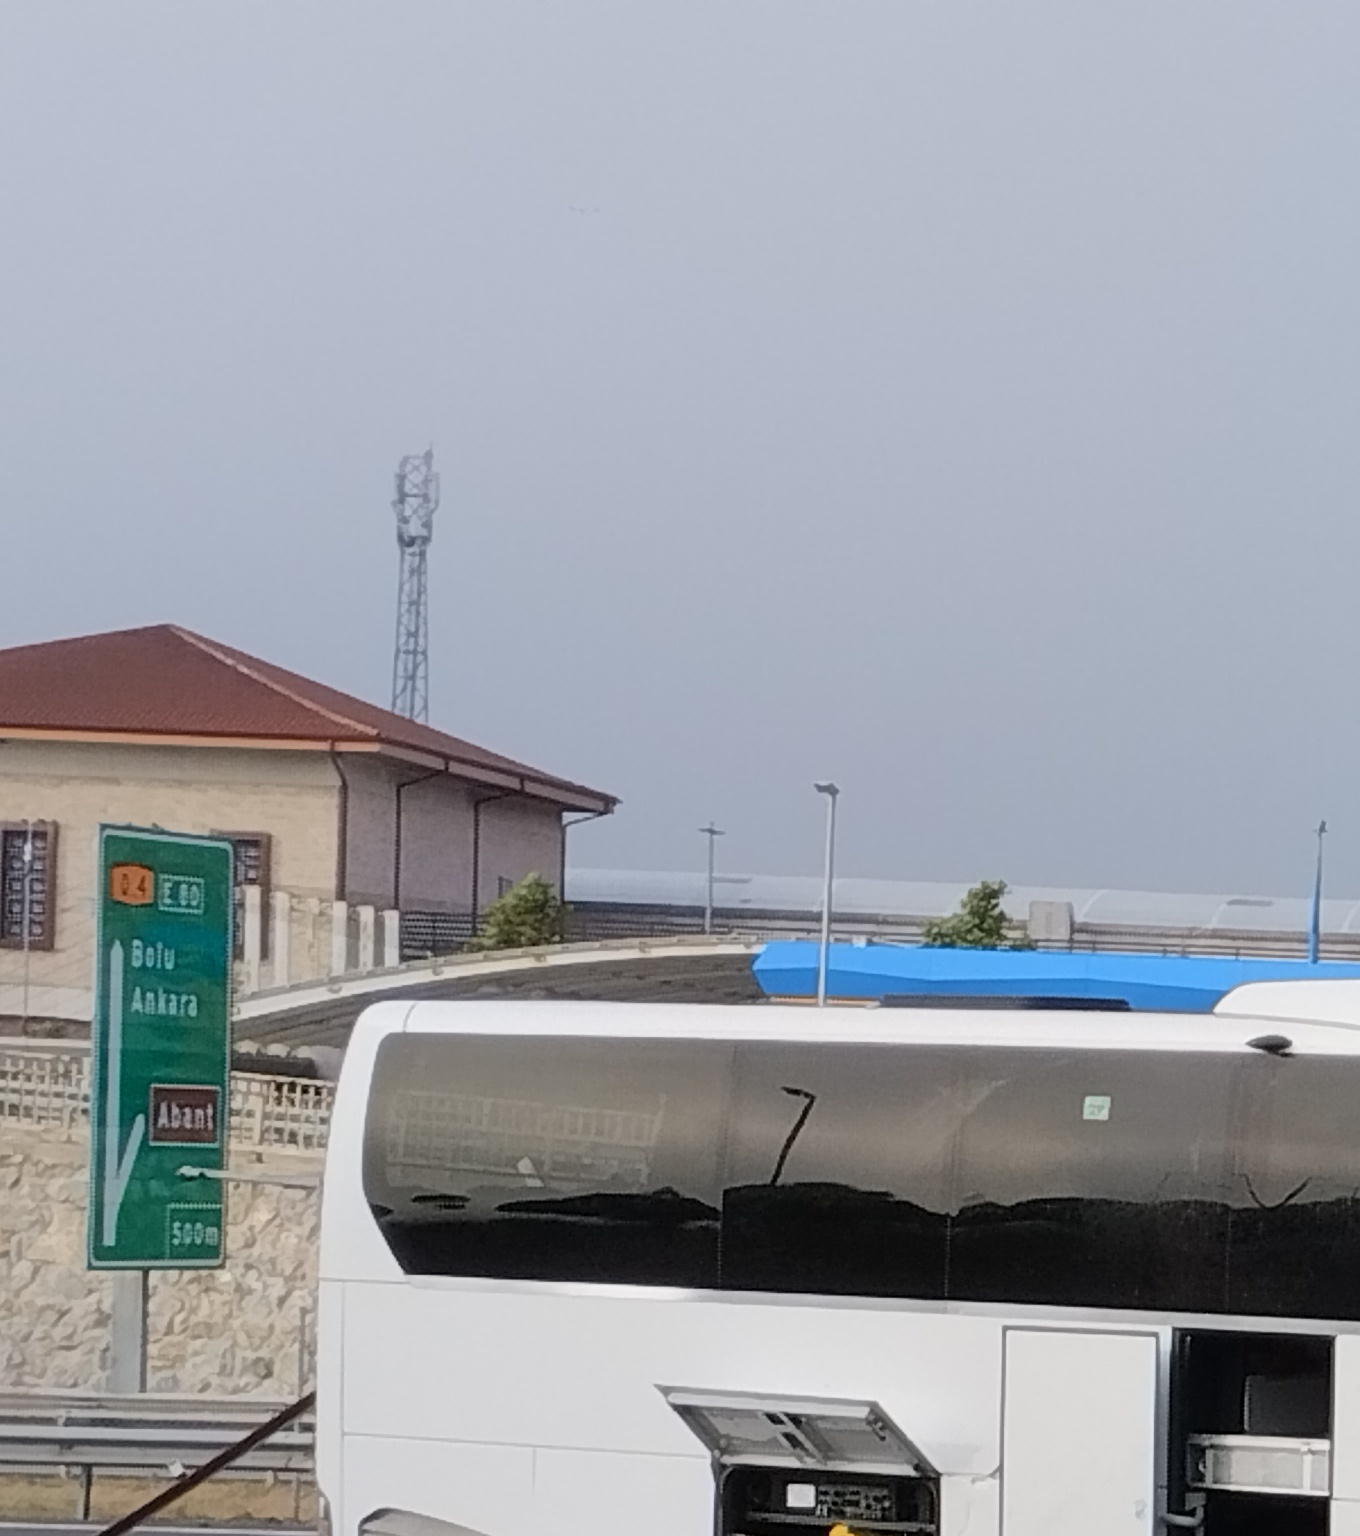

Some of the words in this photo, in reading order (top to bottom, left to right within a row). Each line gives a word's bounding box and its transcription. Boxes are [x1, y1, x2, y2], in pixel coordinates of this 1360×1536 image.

[131, 938, 175, 970] Bolu
[130, 986, 198, 1018] Ankara
[157, 1101, 214, 1131] Abant
